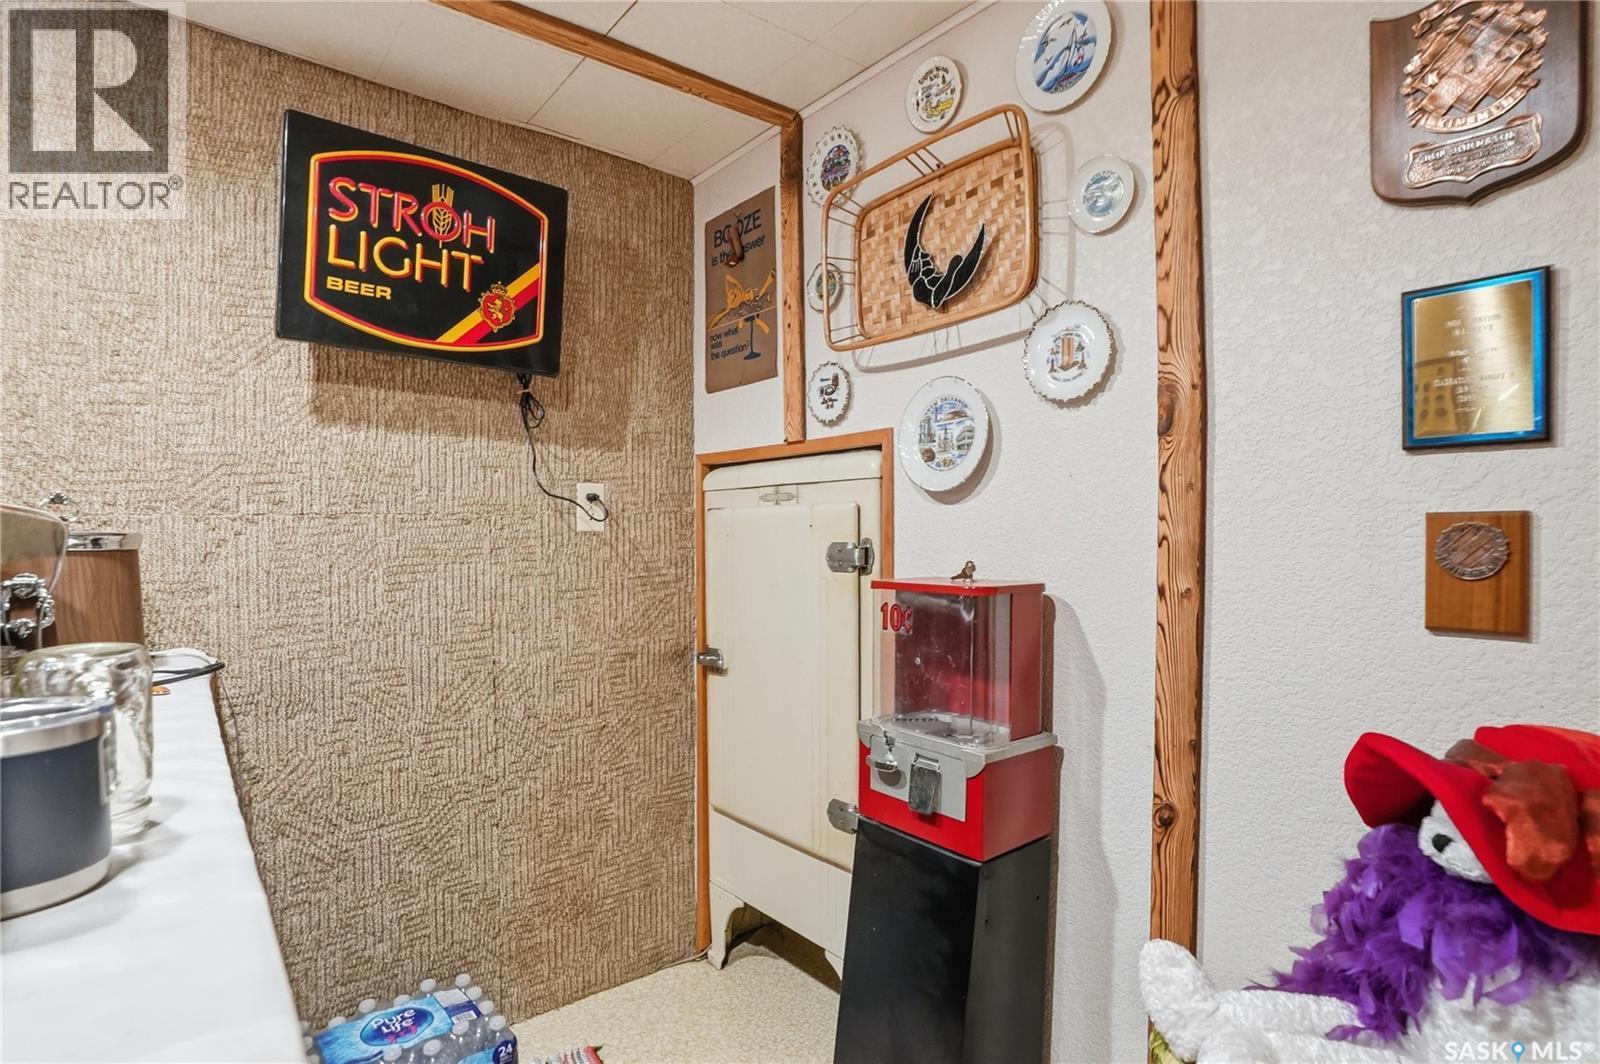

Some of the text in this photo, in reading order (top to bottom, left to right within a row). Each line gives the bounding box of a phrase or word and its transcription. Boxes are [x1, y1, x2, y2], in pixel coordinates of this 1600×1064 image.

[328, 176, 496, 254] STROH
[327, 224, 485, 293] LIGHT
[326, 275, 392, 301] BEER
[498, 1043, 513, 1057] 24
